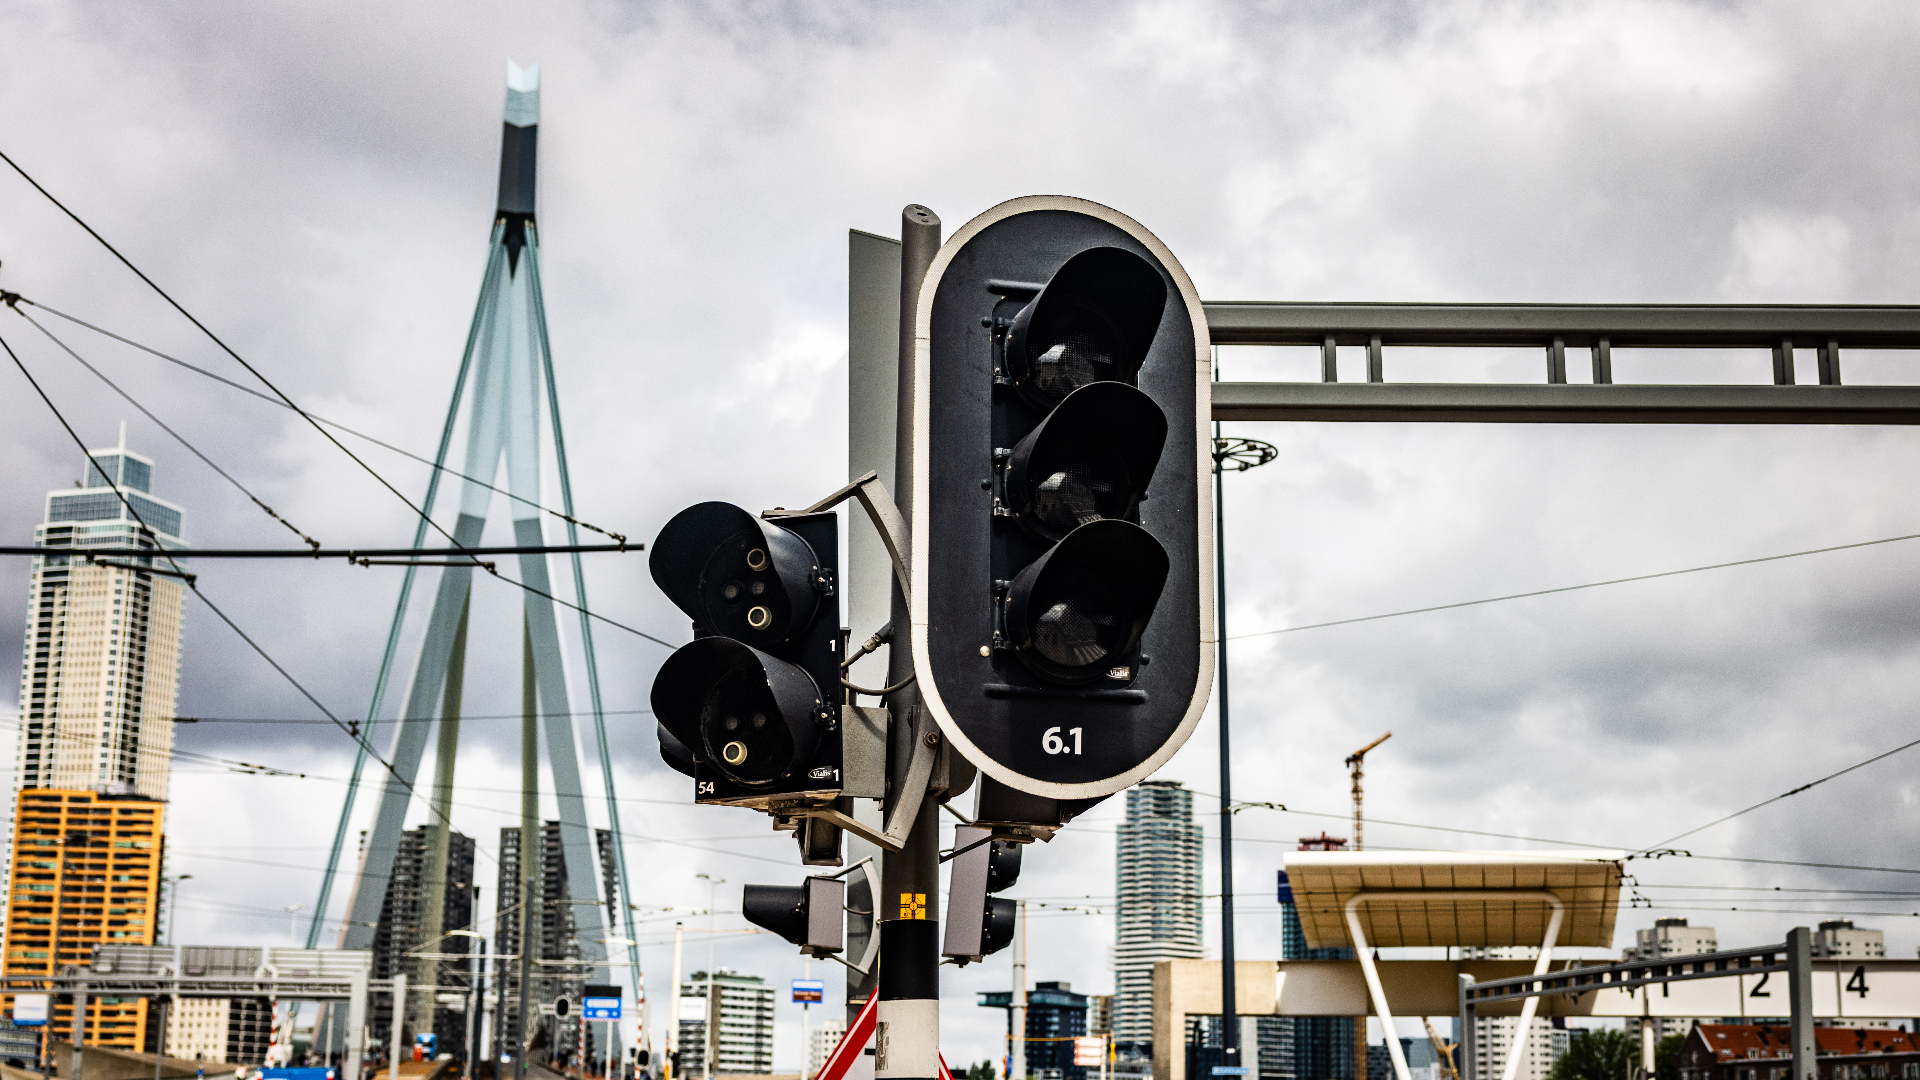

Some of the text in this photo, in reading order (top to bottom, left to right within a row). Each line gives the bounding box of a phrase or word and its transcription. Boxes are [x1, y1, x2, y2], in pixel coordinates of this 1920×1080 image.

[830, 639, 836, 651] 1
[1042, 726, 1083, 755] 6.1
[833, 769, 839, 781] 1
[698, 781, 715, 795] 54
[1749, 972, 1771, 998] 2
[1845, 965, 1870, 998] 4
